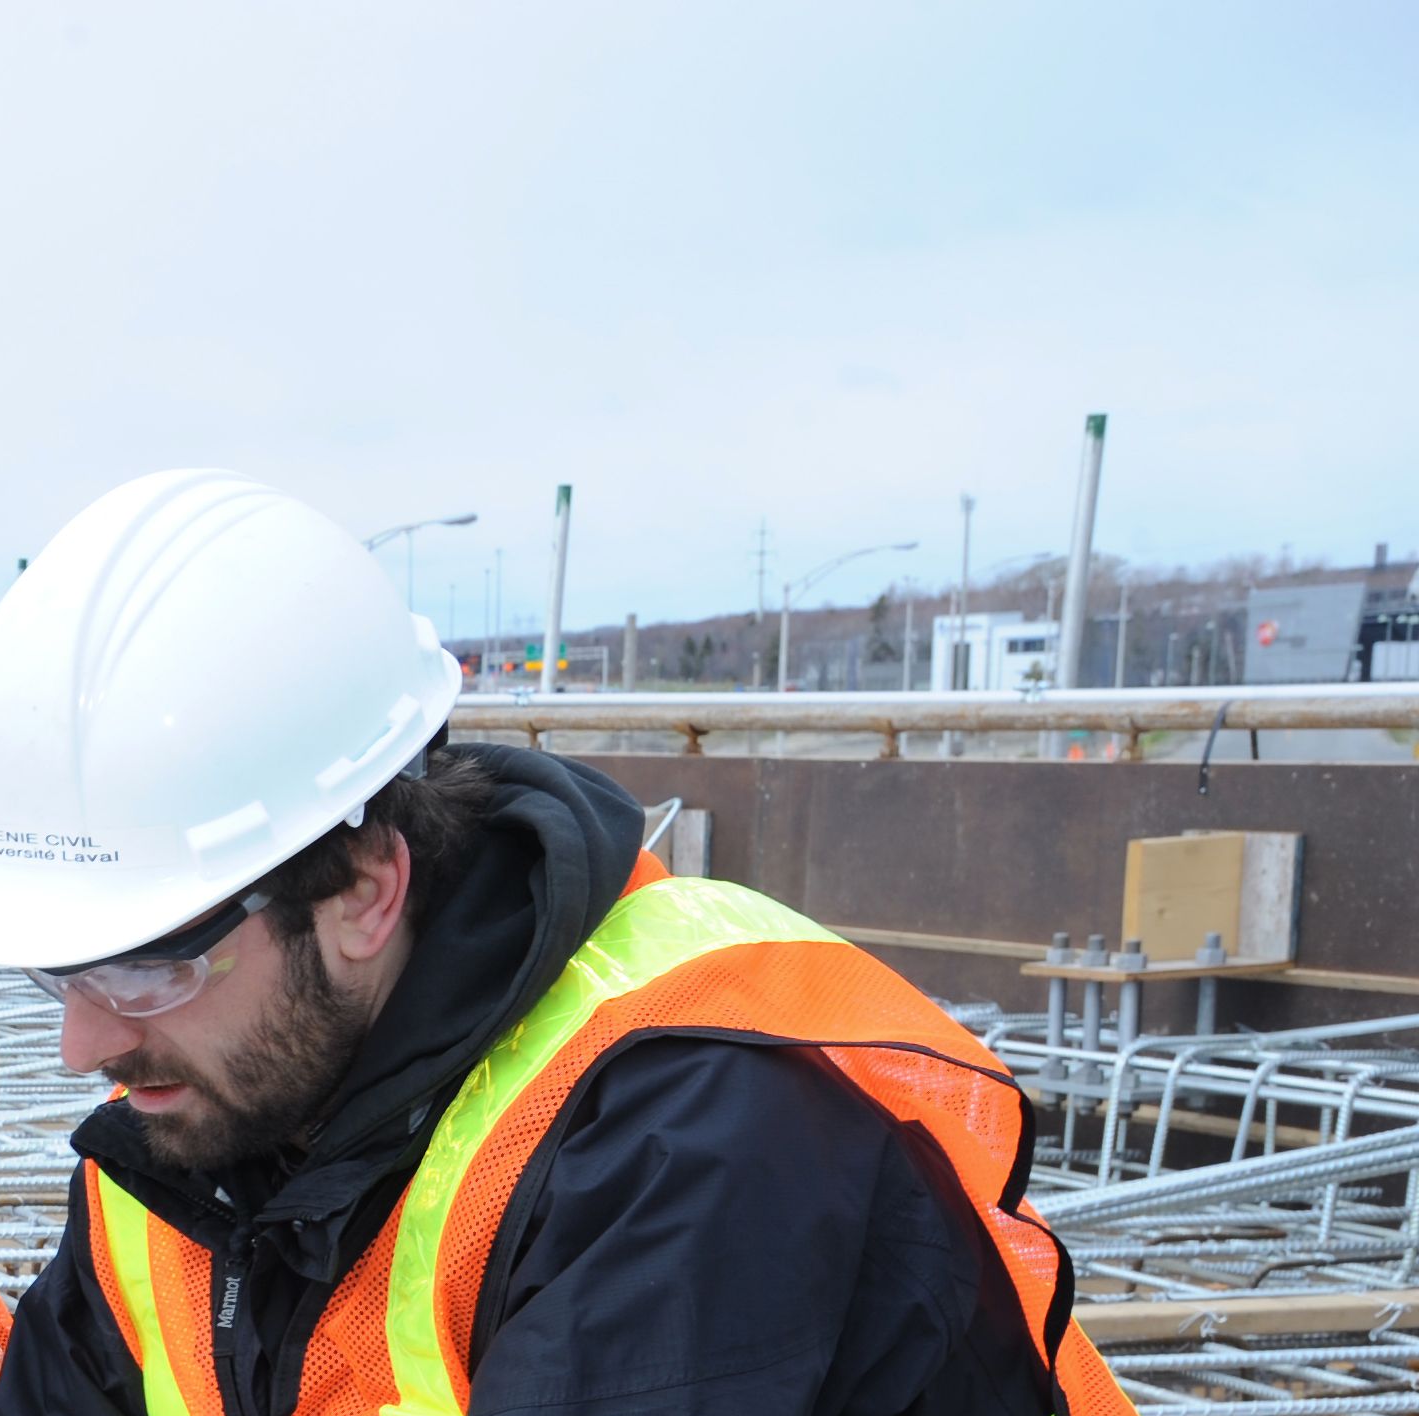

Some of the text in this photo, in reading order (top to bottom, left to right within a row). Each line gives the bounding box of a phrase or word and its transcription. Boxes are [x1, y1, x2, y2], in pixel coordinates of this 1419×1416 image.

[45, 834, 102, 849] CIVIL
[63, 850, 119, 863] Laval
[217, 1276, 241, 1329] Marmot
